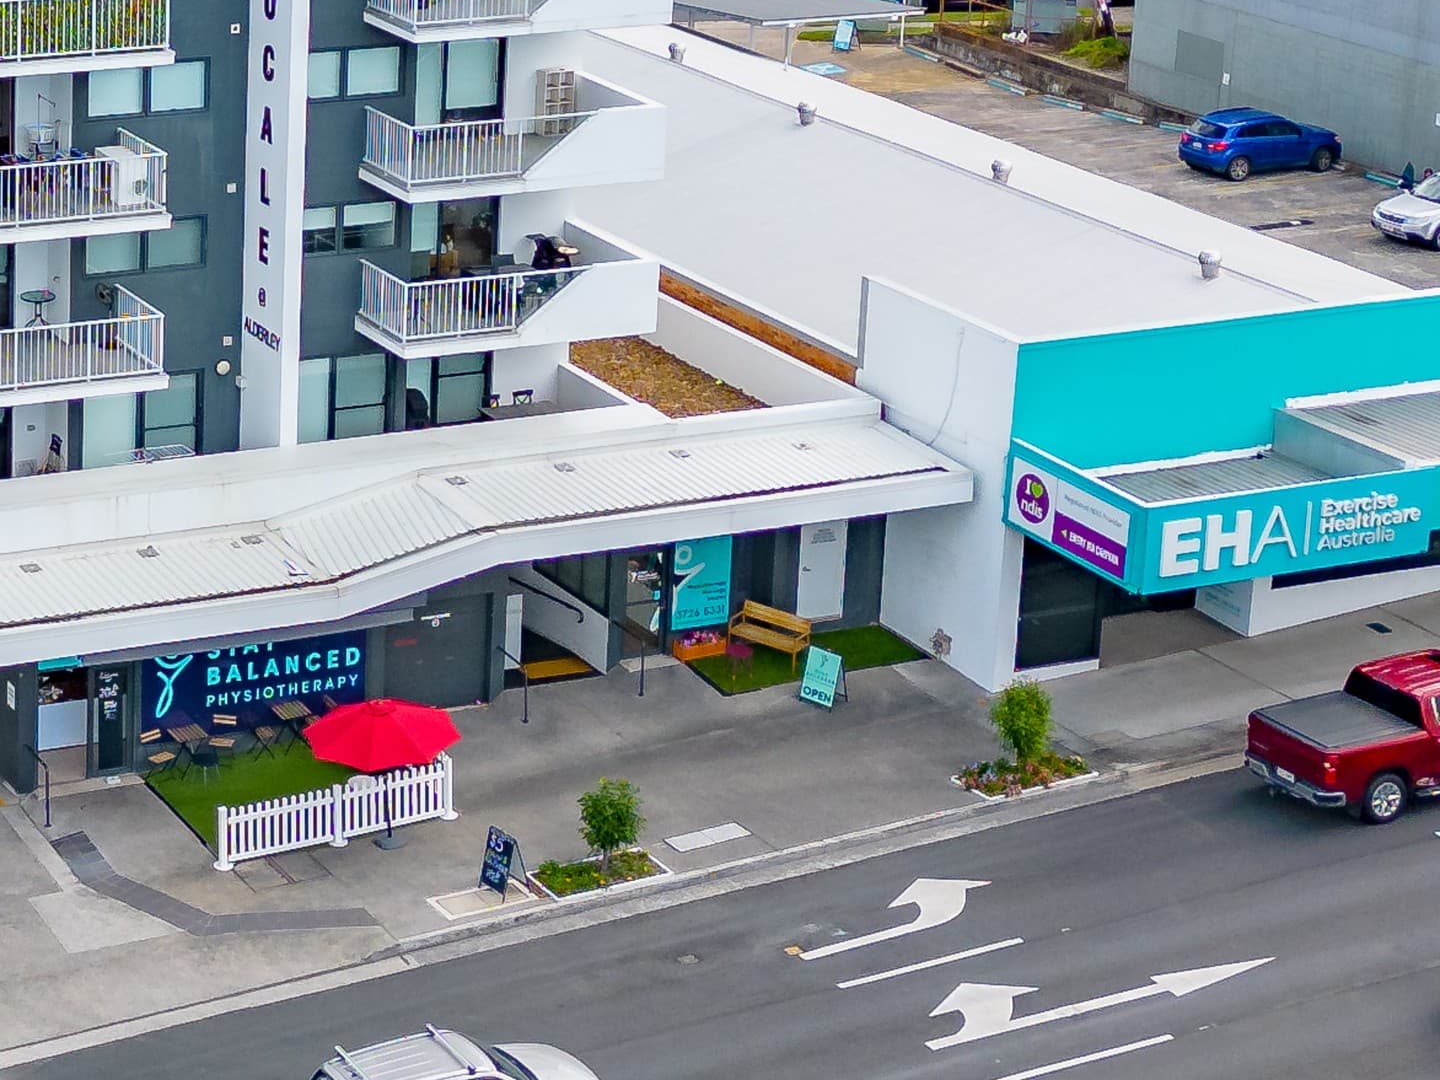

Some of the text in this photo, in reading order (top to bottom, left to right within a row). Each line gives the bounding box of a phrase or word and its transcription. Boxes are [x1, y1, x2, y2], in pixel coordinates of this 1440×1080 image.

[244, 316, 281, 352] ALDERLEY
[1021, 499, 1043, 519] ndis
[1321, 491, 1399, 518] Exercise
[1319, 506, 1422, 534] Healthcare
[1160, 505, 1298, 578] EHA
[1317, 528, 1396, 552] Australia
[207, 647, 361, 687] BALANCED
[206, 674, 359, 708] PHYSIOTHERAPY
[803, 686, 832, 703] OPEN
